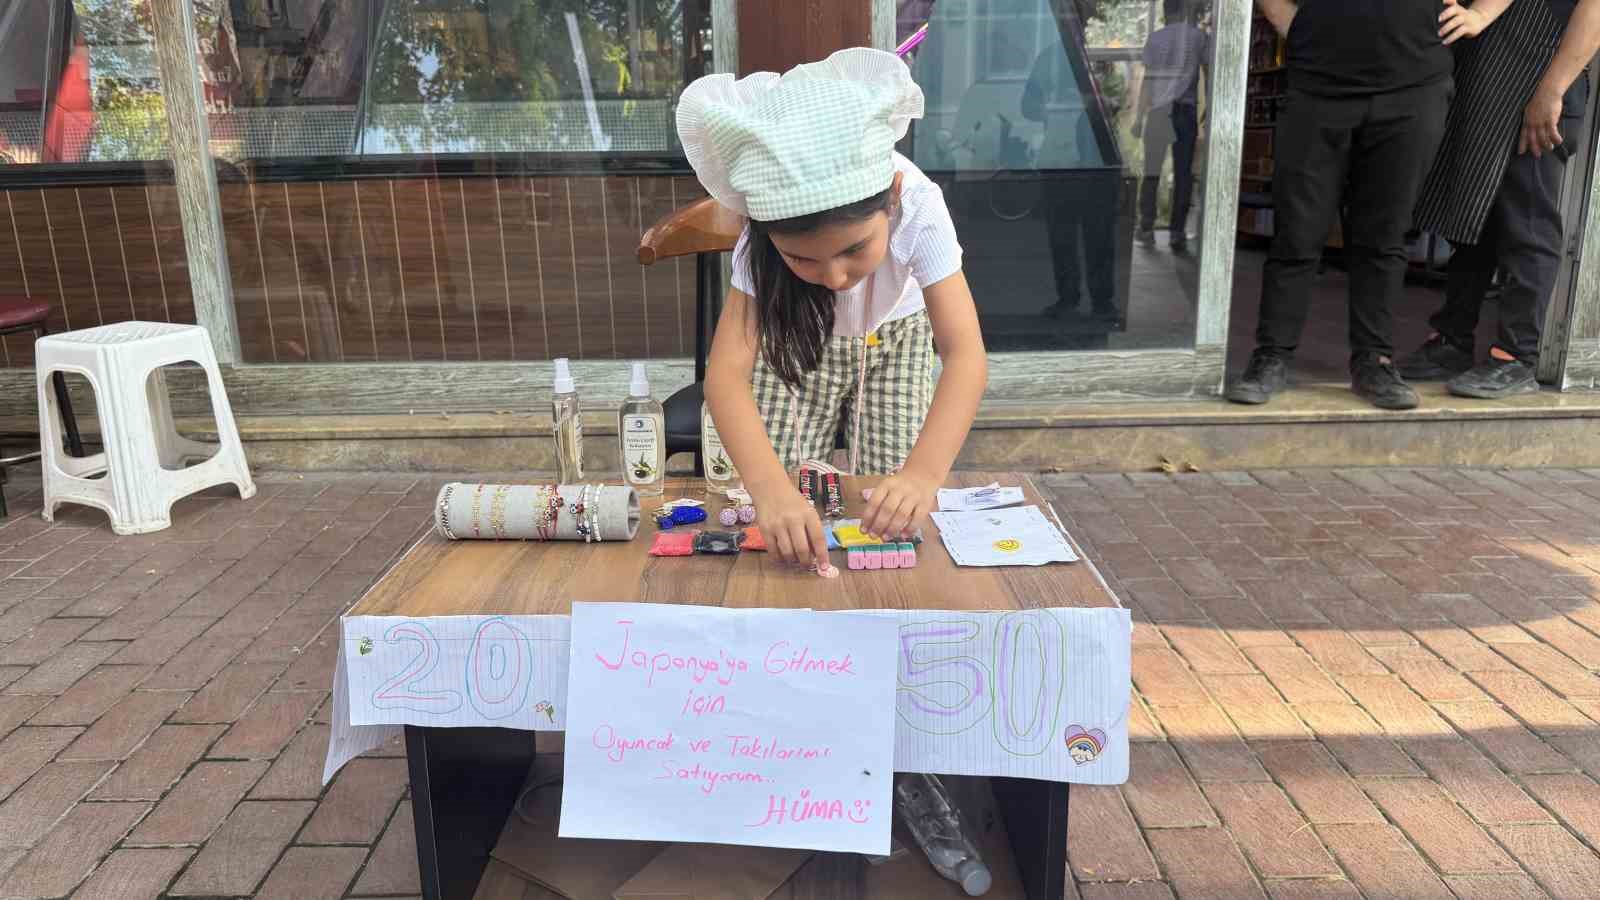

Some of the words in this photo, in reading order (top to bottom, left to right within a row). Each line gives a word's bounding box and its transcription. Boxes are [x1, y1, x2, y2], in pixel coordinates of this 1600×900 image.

[372, 616, 533, 720] 20
[595, 619, 751, 688] Japanya'ya
[764, 640, 857, 675] Gitmek
[682, 689, 726, 715] için
[896, 609, 1066, 756] 50
[592, 724, 674, 763] Oyuncak
[688, 738, 712, 754] ve
[744, 789, 844, 828] HÜMA
